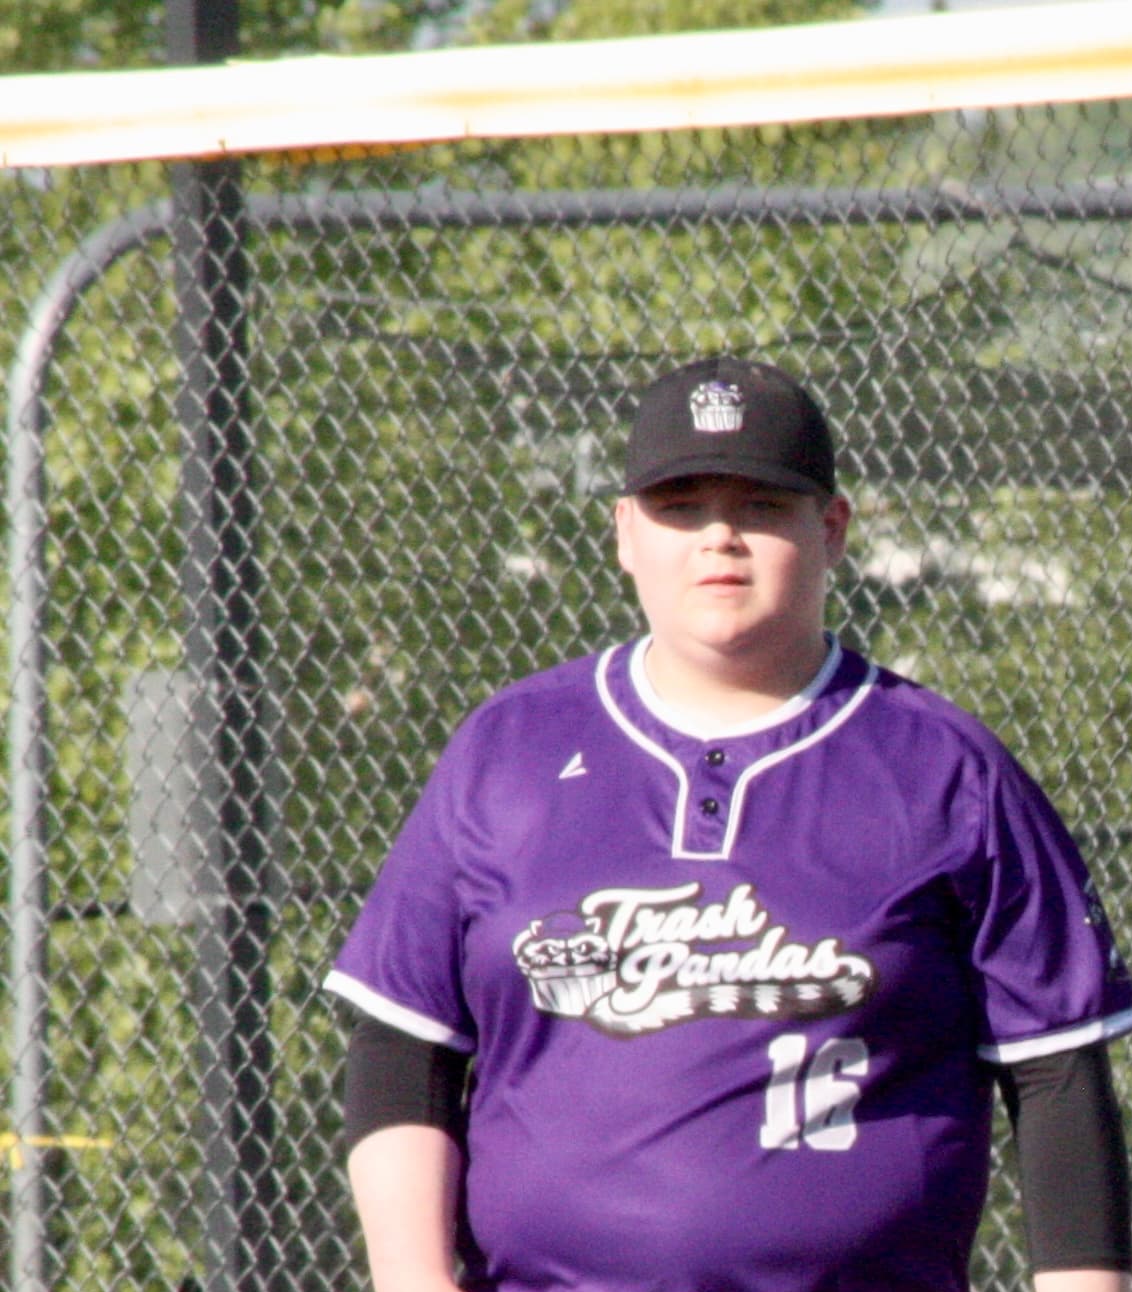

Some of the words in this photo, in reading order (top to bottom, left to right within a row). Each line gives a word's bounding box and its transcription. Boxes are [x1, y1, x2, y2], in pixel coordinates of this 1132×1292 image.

[582, 882, 767, 951] Trash
[609, 926, 841, 1014] Pandas
[760, 1033, 869, 1151] 16
